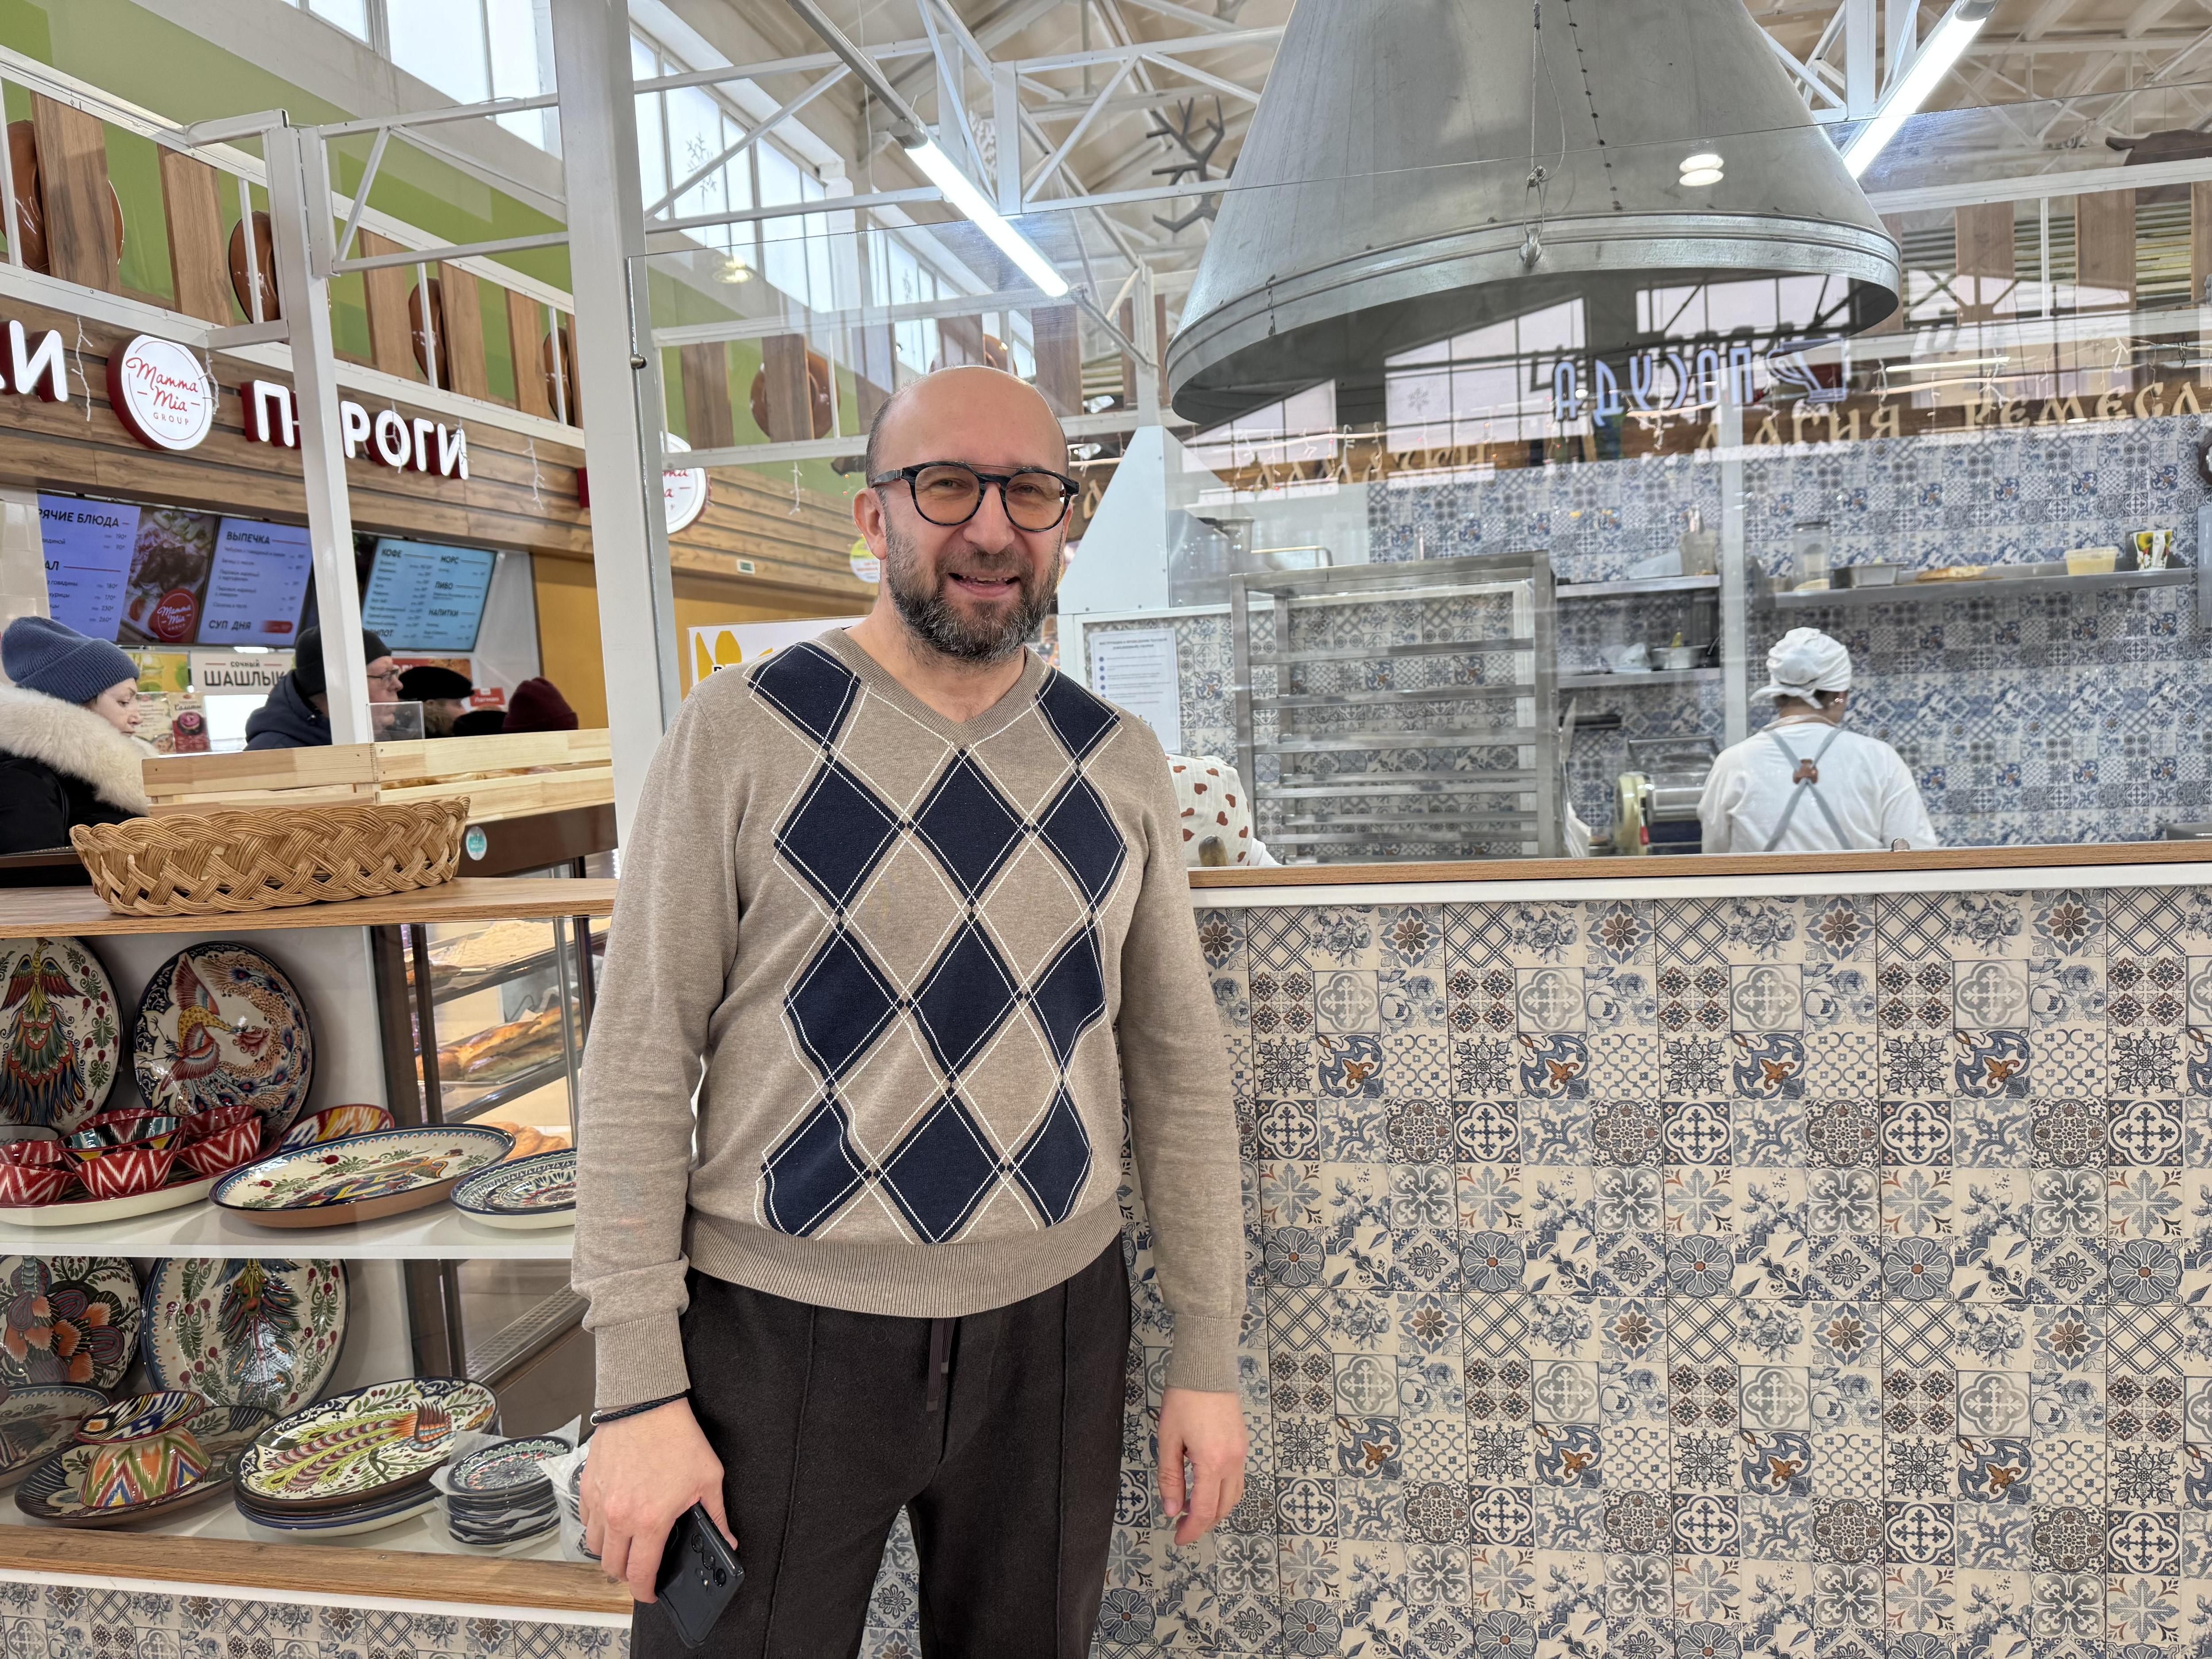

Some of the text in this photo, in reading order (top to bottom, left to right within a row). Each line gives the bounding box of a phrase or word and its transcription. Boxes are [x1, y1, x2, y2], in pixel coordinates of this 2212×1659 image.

[126, 357, 198, 392] Mamma
[154, 386, 187, 411] Mia
[153, 412, 189, 425] GROUP
[253, 380, 469, 480] ПРОГИ
[77, 513, 119, 528] БЛЮДА
[226, 531, 270, 545] ВЫПЕЧКА
[381, 548, 403, 558] КОФЕ
[441, 556, 459, 565] МОРС
[435, 581, 453, 590] ПИВО
[428, 608, 459, 617] НАПИТКИ
[208, 620, 252, 631] СУП ДНЯ
